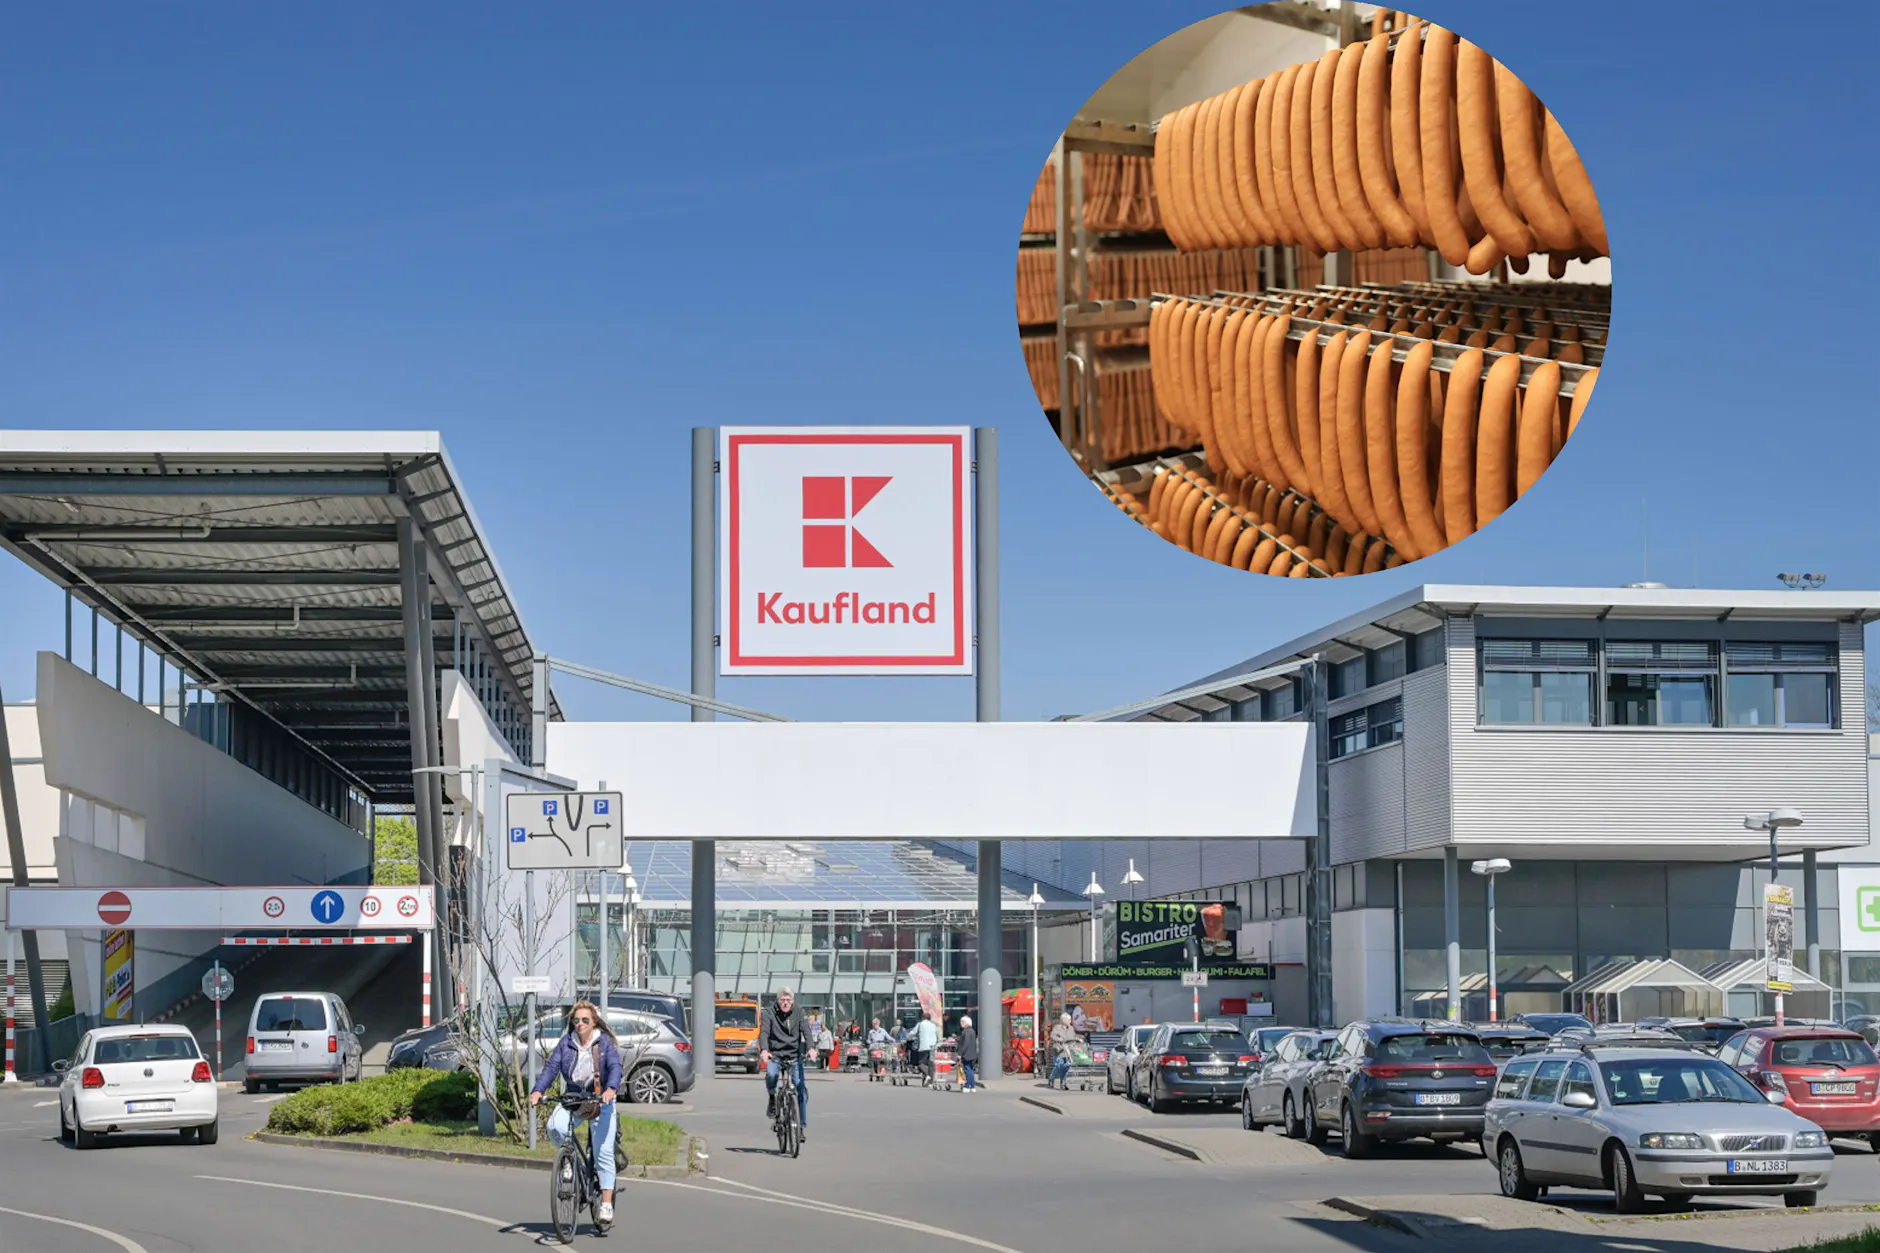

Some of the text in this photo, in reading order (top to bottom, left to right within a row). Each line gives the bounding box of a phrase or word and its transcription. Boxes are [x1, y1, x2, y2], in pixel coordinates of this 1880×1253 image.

[757, 591, 936, 625] Kaufland
[365, 901, 376, 912] 10
[1120, 902, 1198, 923] BISTRO
[1120, 923, 1196, 949] Samariter
[1062, 965, 1094, 977] DÖNER
[1098, 965, 1132, 977] DÜRÜM
[1136, 967, 1173, 977] BURGER
[1228, 967, 1267, 976] FALAFEL
[1747, 1161, 1760, 1171] NL
[1762, 1160, 1786, 1171] 1383
